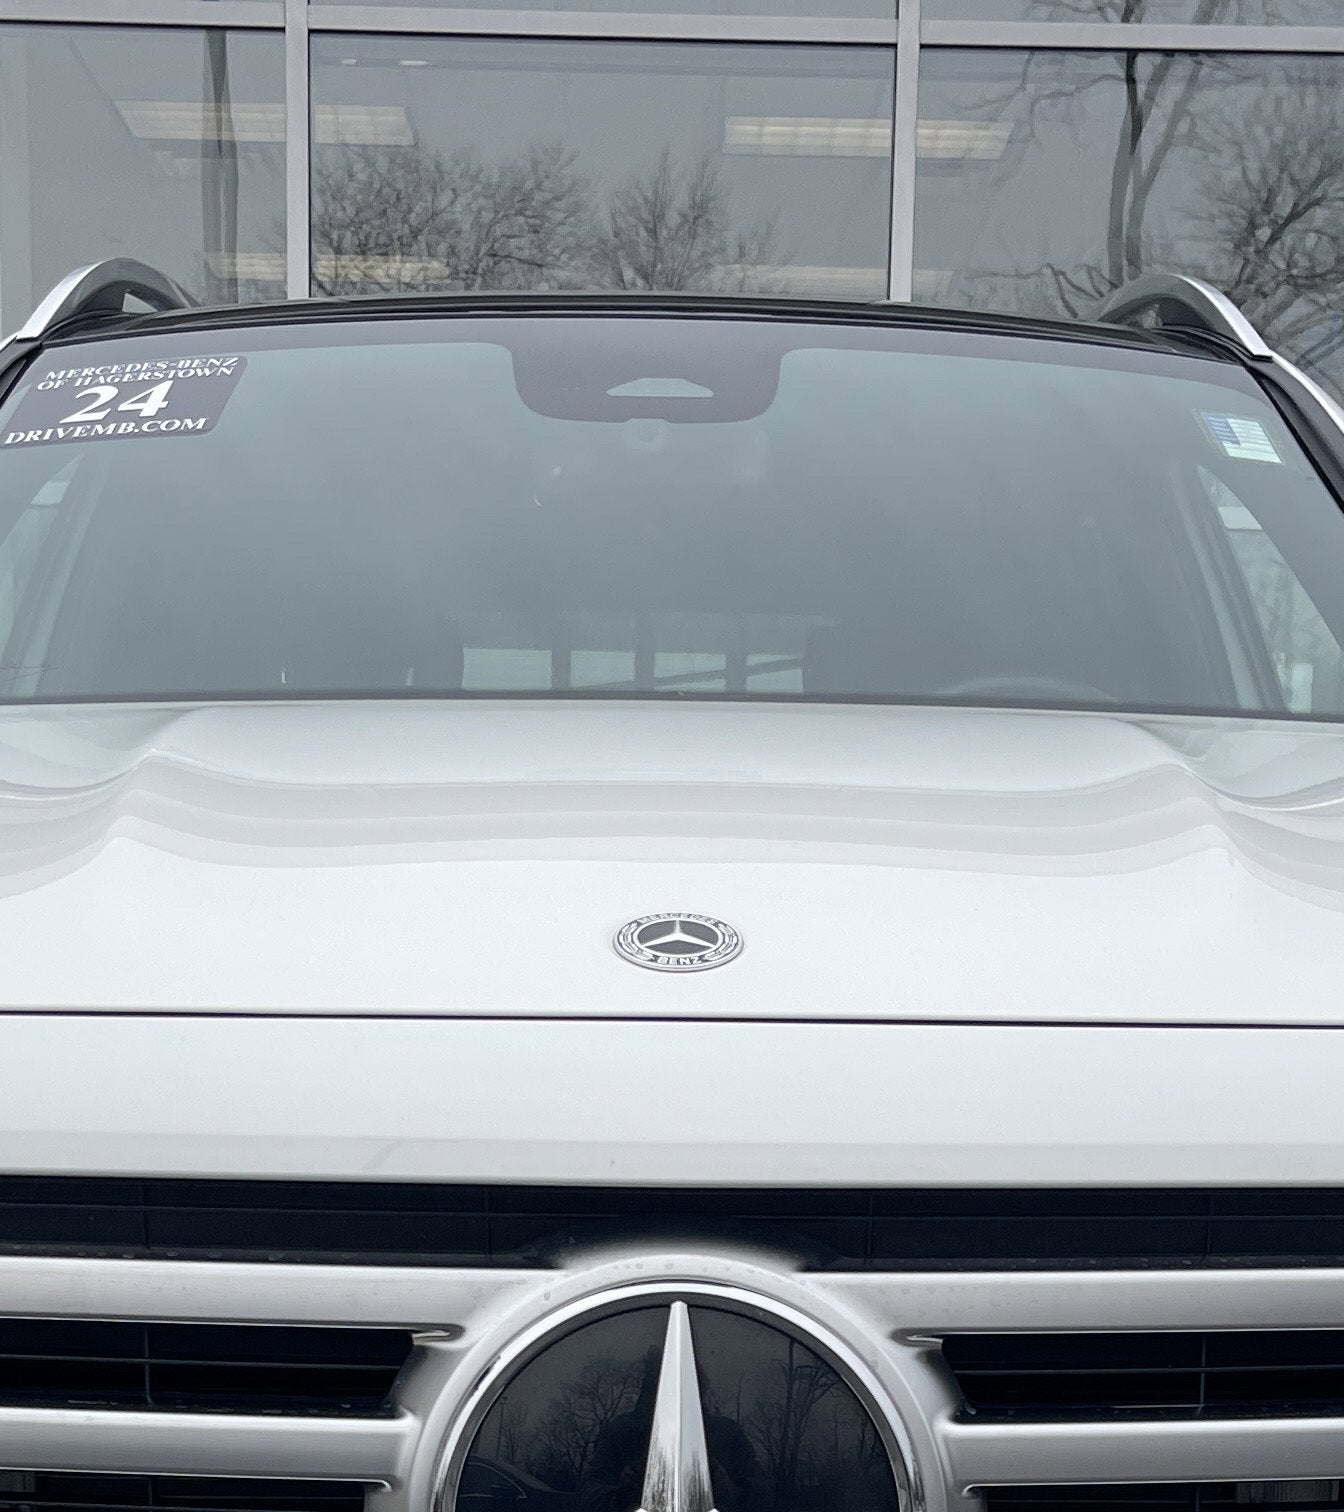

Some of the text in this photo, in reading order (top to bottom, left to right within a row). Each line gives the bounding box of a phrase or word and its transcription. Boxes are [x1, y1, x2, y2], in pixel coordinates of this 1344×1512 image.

[37, 366, 235, 391] OF HAGERSTOWN
[46, 356, 239, 380] MERCEDES-BENZ
[59, 380, 174, 424] 24
[4, 417, 208, 445] DRIVEMB.COM
